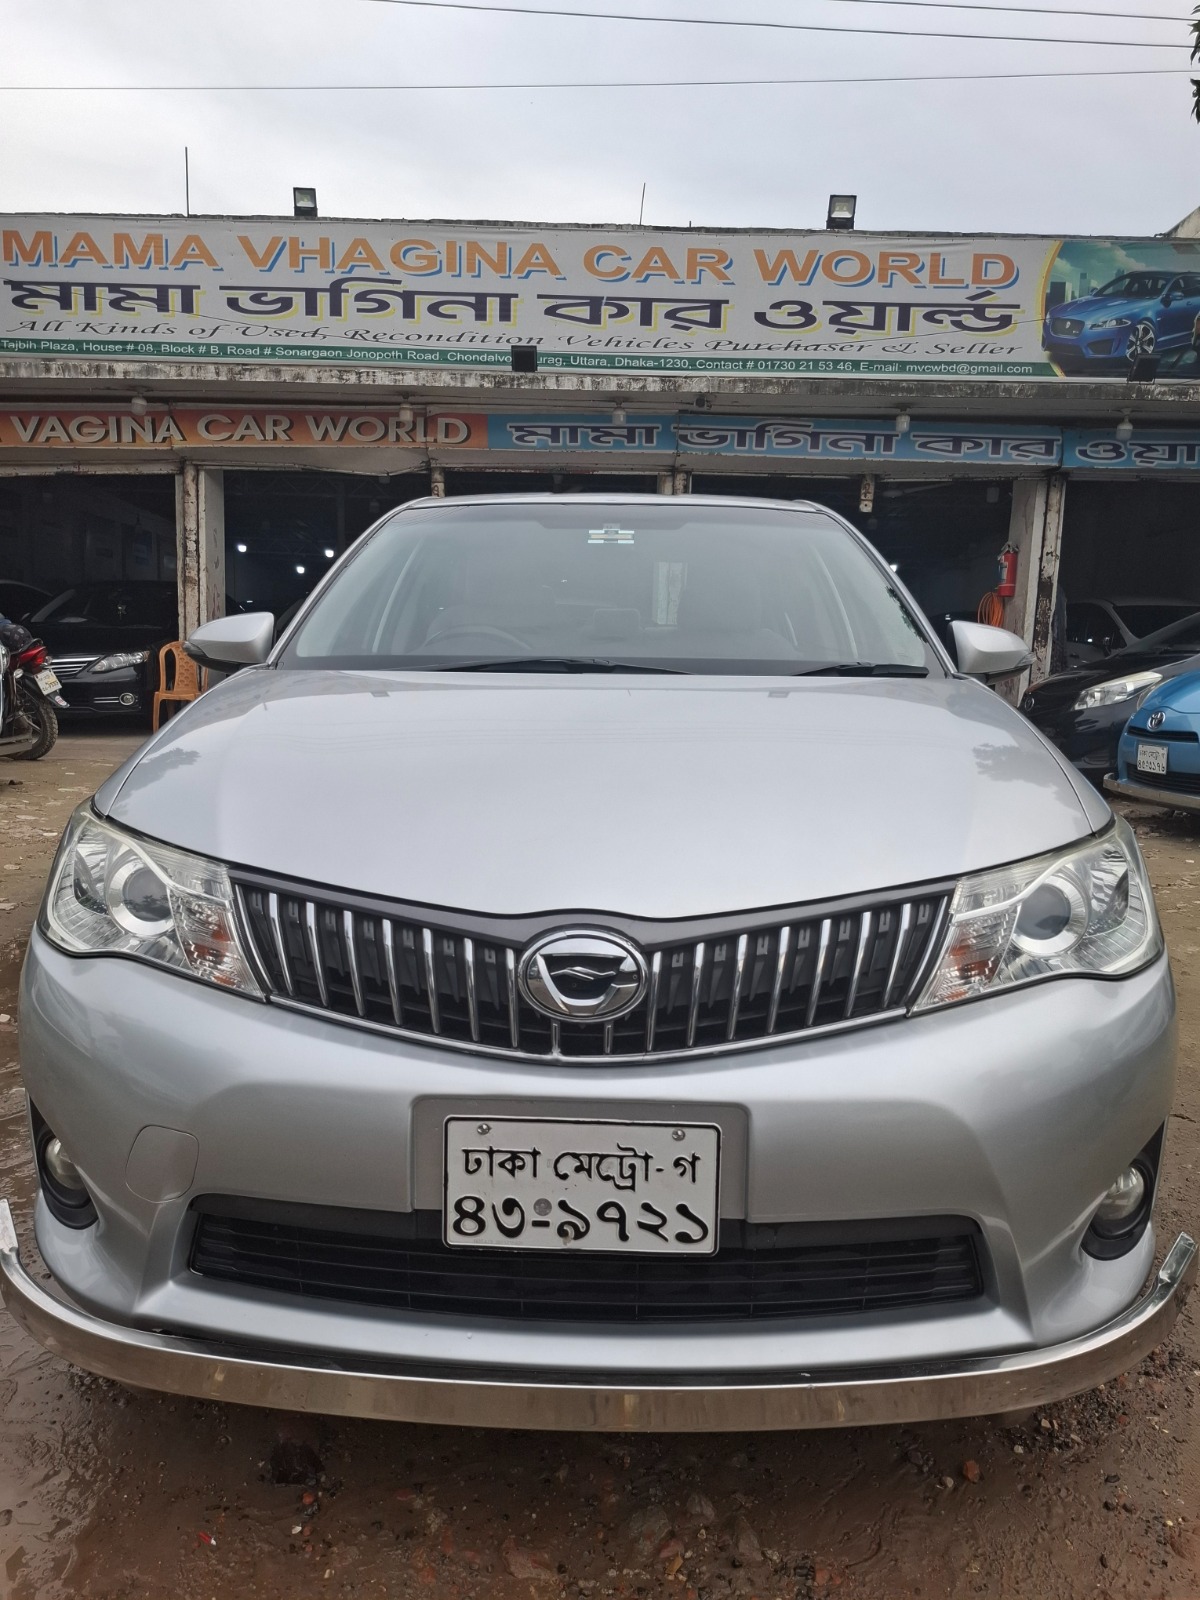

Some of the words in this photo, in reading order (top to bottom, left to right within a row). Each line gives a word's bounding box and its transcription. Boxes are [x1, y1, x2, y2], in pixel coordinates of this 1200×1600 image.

[2, 230, 222, 270] MAMA
[237, 235, 563, 279] VHAGINA
[584, 243, 733, 285] CAR
[754, 248, 1019, 288] WORLD
[3, 280, 201, 315] মামা
[219, 277, 520, 323] ভাগিনা
[537, 295, 730, 331] কার
[754, 290, 1021, 335] ওয়ার্ল্ড
[6, 320, 72, 333] All
[76, 321, 178, 335] Kinds
[188, 324, 230, 339] of
[232, 325, 329, 341] Used,
[343, 329, 545, 345] Recondition
[557, 335, 695, 350] Vehicles
[703, 339, 873, 353] Purchaser
[882, 341, 920, 354] &
[925, 342, 1023, 355] Seller
[1, 340, 37, 351] Tajbih
[41, 341, 78, 353] Plaza,
[84, 342, 123, 353] House
[126, 343, 135, 353] #
[138, 343, 157, 355] 08,
[161, 343, 195, 354] Block
[198, 345, 207, 355] #
[210, 345, 223, 357] B,
[227, 346, 260, 356] Road
[263, 346, 272, 356] #
[275, 347, 343, 359] Sonargaon
[346, 348, 403, 360] Jonopoth
[407, 350, 443, 361] Road.
[570, 356, 611, 368] Uttara,
[615, 357, 692, 370] Dhaka-1230,
[696, 359, 743, 370] Contact
[746, 360, 755, 370] #
[758, 360, 796, 371] 01730
[799, 361, 814, 371] 21
[818, 361, 834, 371] 53
[837, 362, 856, 374] 46,
[860, 362, 902, 372] E-mail:
[906, 363, 1033, 375] mvcwbd@gmail.com
[9, 414, 185, 444] VAGINA
[197, 414, 294, 442] CAR
[305, 414, 471, 444] WORLD
[507, 423, 662, 447] মামা
[673, 420, 901, 453] ভাগিনা
[911, 433, 1061, 459] কার
[462, 1145, 541, 1178] ঢাকা
[452, 1195, 709, 1244] ৪৩-৯৭২১
